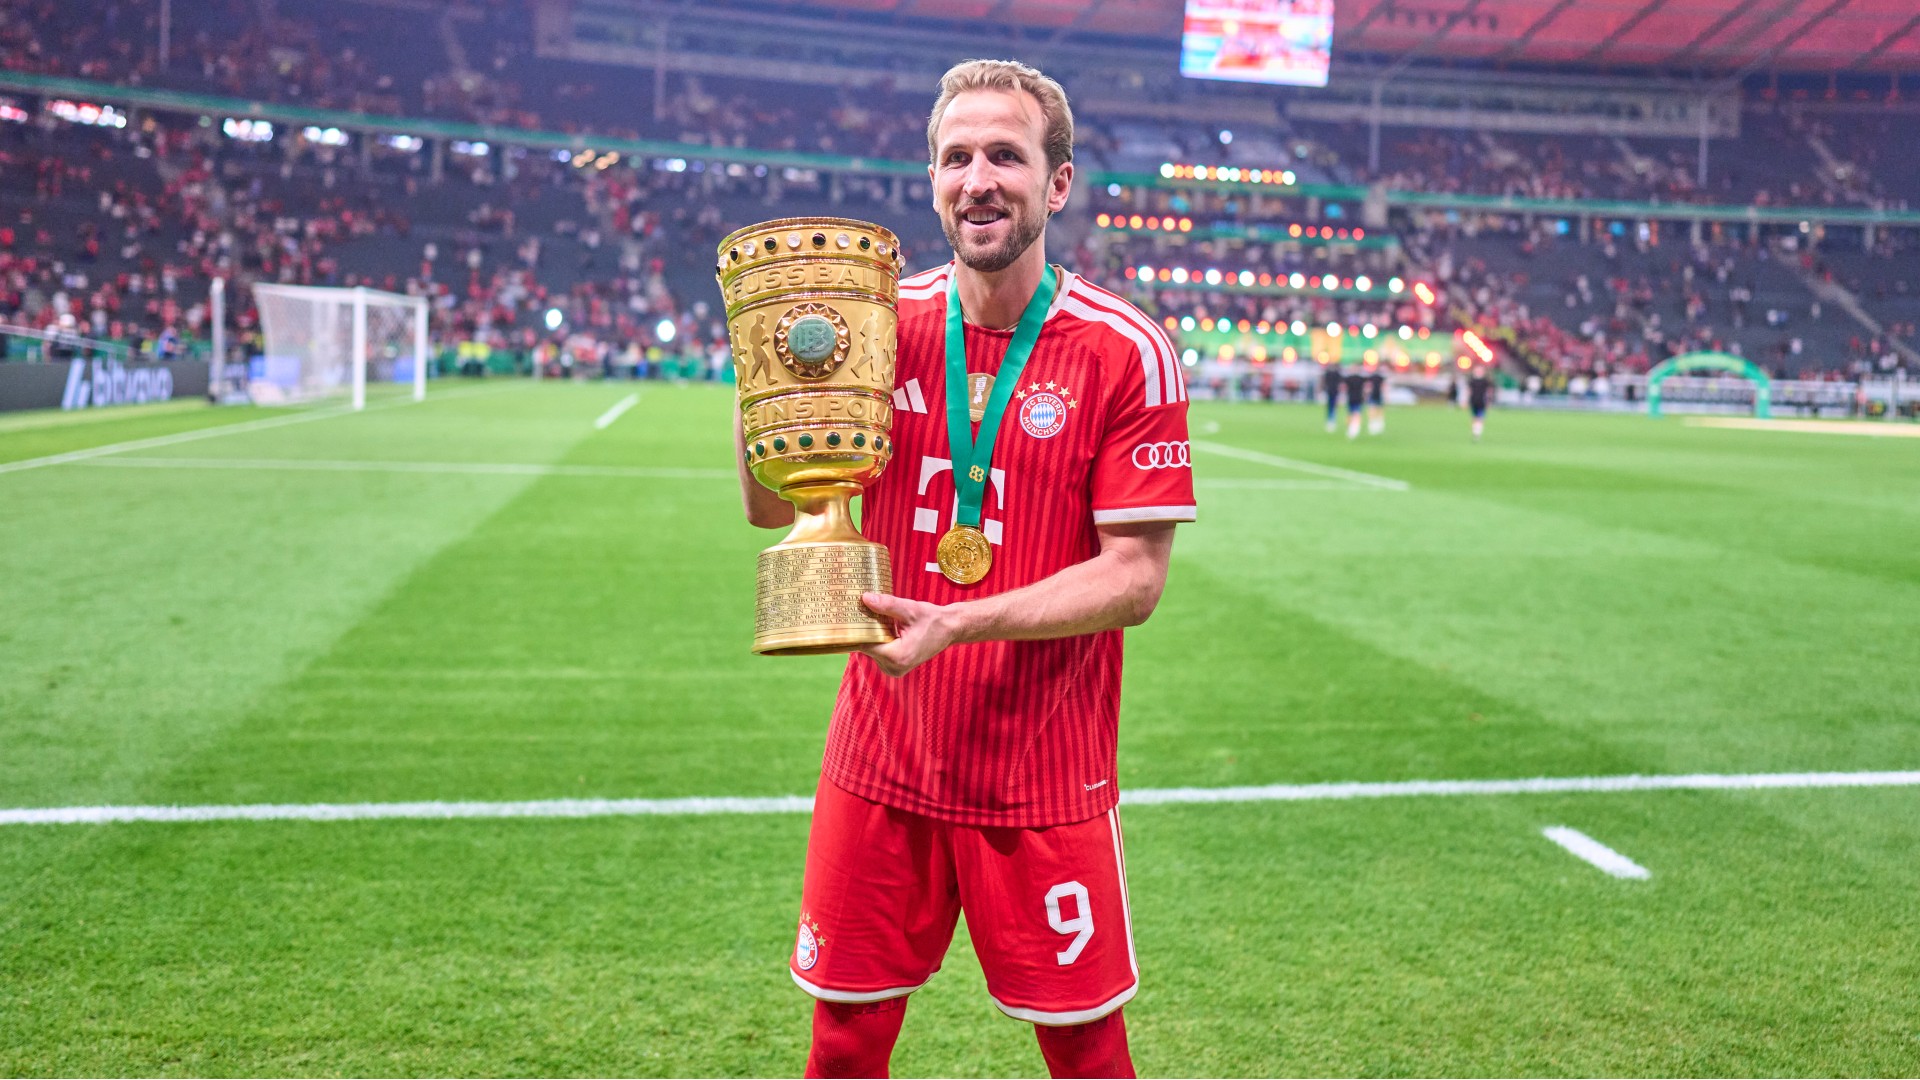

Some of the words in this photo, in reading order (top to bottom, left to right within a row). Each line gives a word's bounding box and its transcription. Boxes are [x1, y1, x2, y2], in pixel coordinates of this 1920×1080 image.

[1025, 400, 1036, 410] FC
[1037, 396, 1064, 416] BAYERN
[1045, 881, 1094, 965] 9
